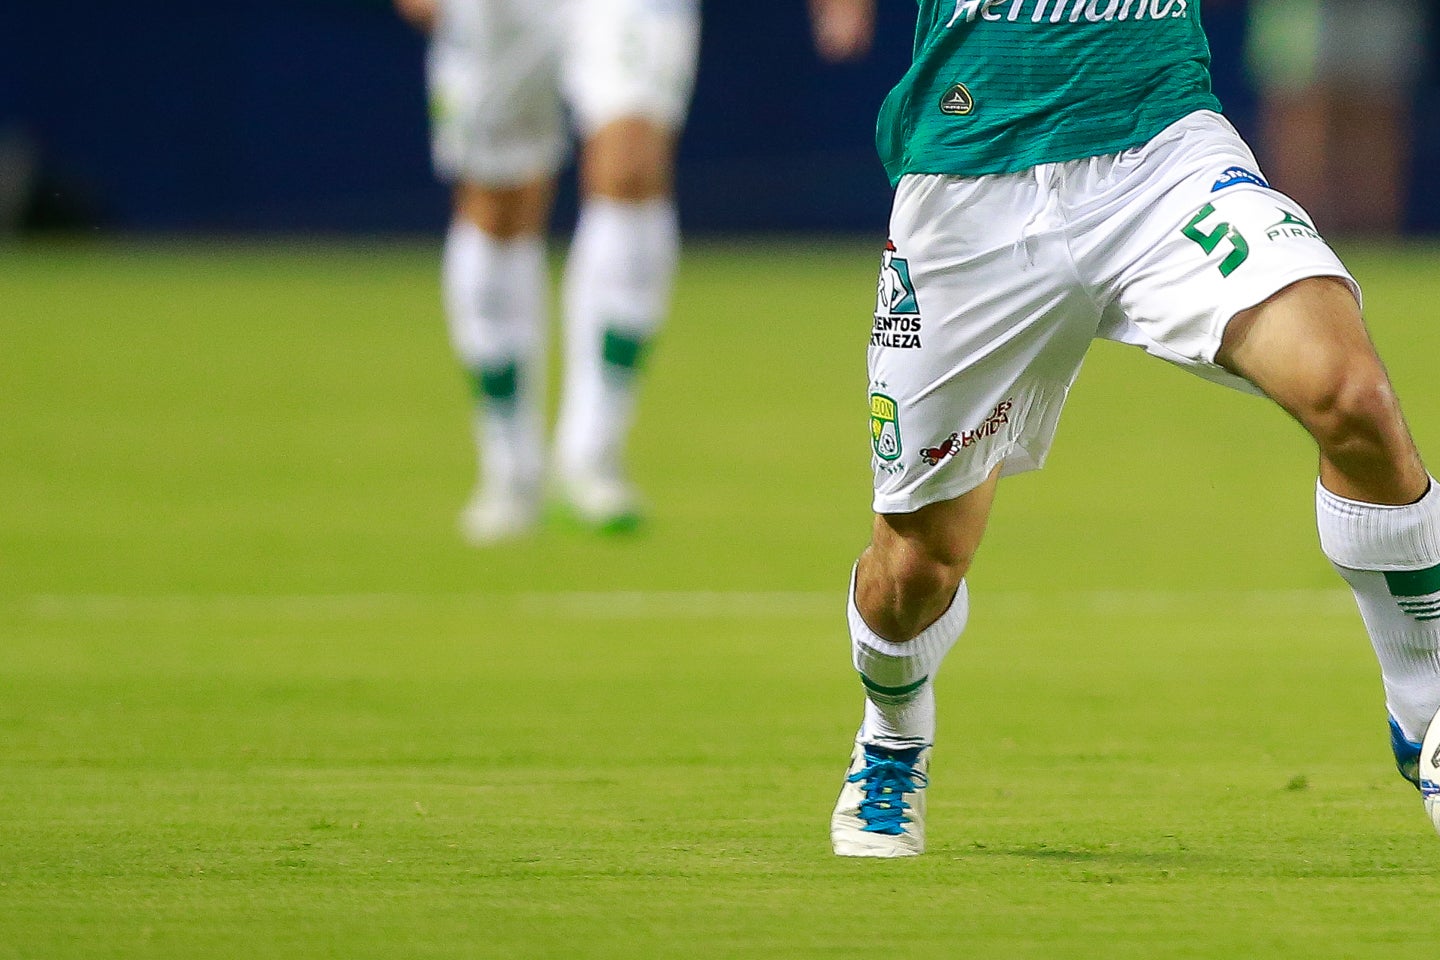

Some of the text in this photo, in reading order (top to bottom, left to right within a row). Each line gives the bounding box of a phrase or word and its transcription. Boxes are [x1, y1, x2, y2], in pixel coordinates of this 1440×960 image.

[1180, 202, 1249, 279] 5
[1266, 228, 1327, 243] PIRM
[875, 316, 922, 332] ENTOS
